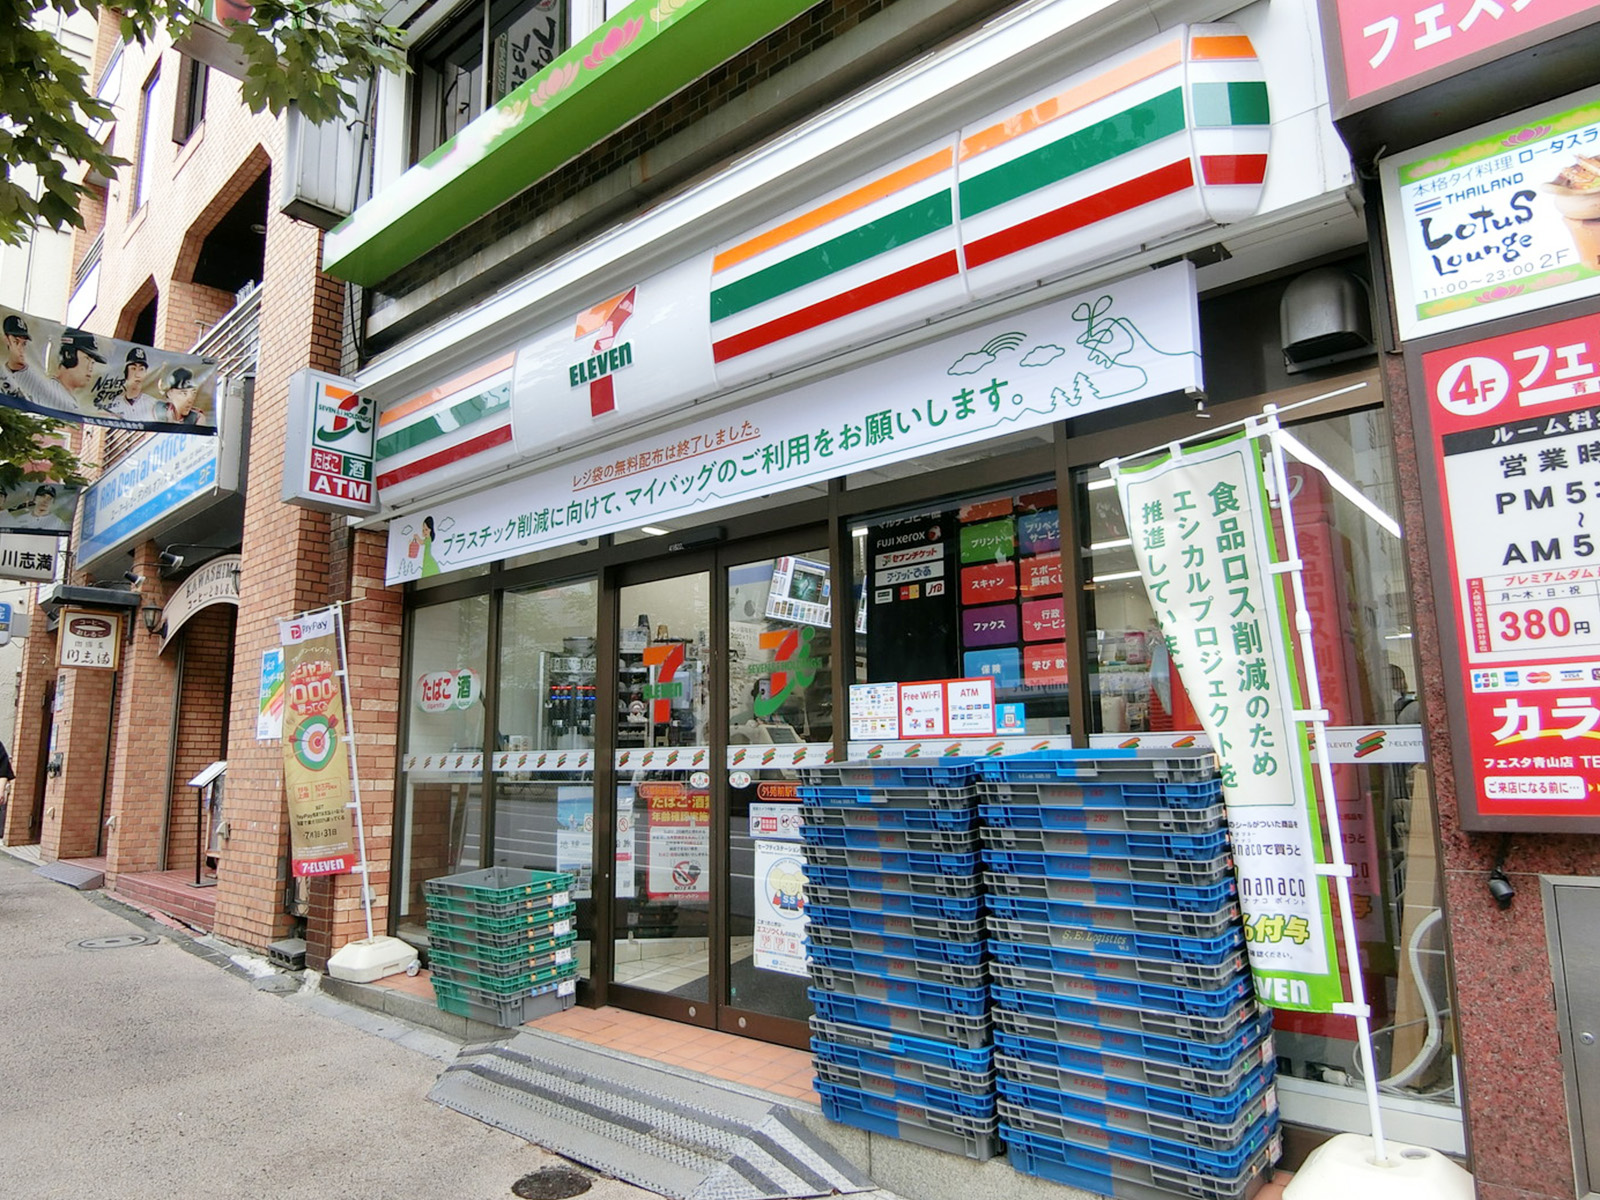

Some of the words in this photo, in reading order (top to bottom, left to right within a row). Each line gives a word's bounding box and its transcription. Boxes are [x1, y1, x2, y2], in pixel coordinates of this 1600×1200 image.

[1413, 155, 1513, 198] 本格タイ料理
[1445, 172, 1524, 205] THAILAND
[1539, 248, 1571, 270] 2F
[313, 451, 339, 472] たばこ
[572, 420, 762, 488] レジ袋の無料配布は終了しました。
[349, 458, 367, 478] 酒
[314, 475, 368, 500] ATM
[877, 539, 895, 549] FUJI
[1, 549, 53, 571] 川志満
[892, 548, 937, 563] セブンチケット
[928, 583, 943, 596] JTB
[972, 578, 1004, 590] スキャン
[973, 620, 1006, 632] ファクス
[1207, 481, 1278, 777] 食品ロス削減のため
[1173, 489, 1239, 789] エシカルプロジェクトを
[422, 677, 452, 702] たばこ
[457, 675, 471, 698] 酒
[903, 691, 919, 700] Free
[920, 689, 941, 699] Wi-Fi
[960, 688, 979, 697] ATM
[1483, 756, 1574, 769] フェスタ青山店
[1243, 877, 1306, 898] nanaco
